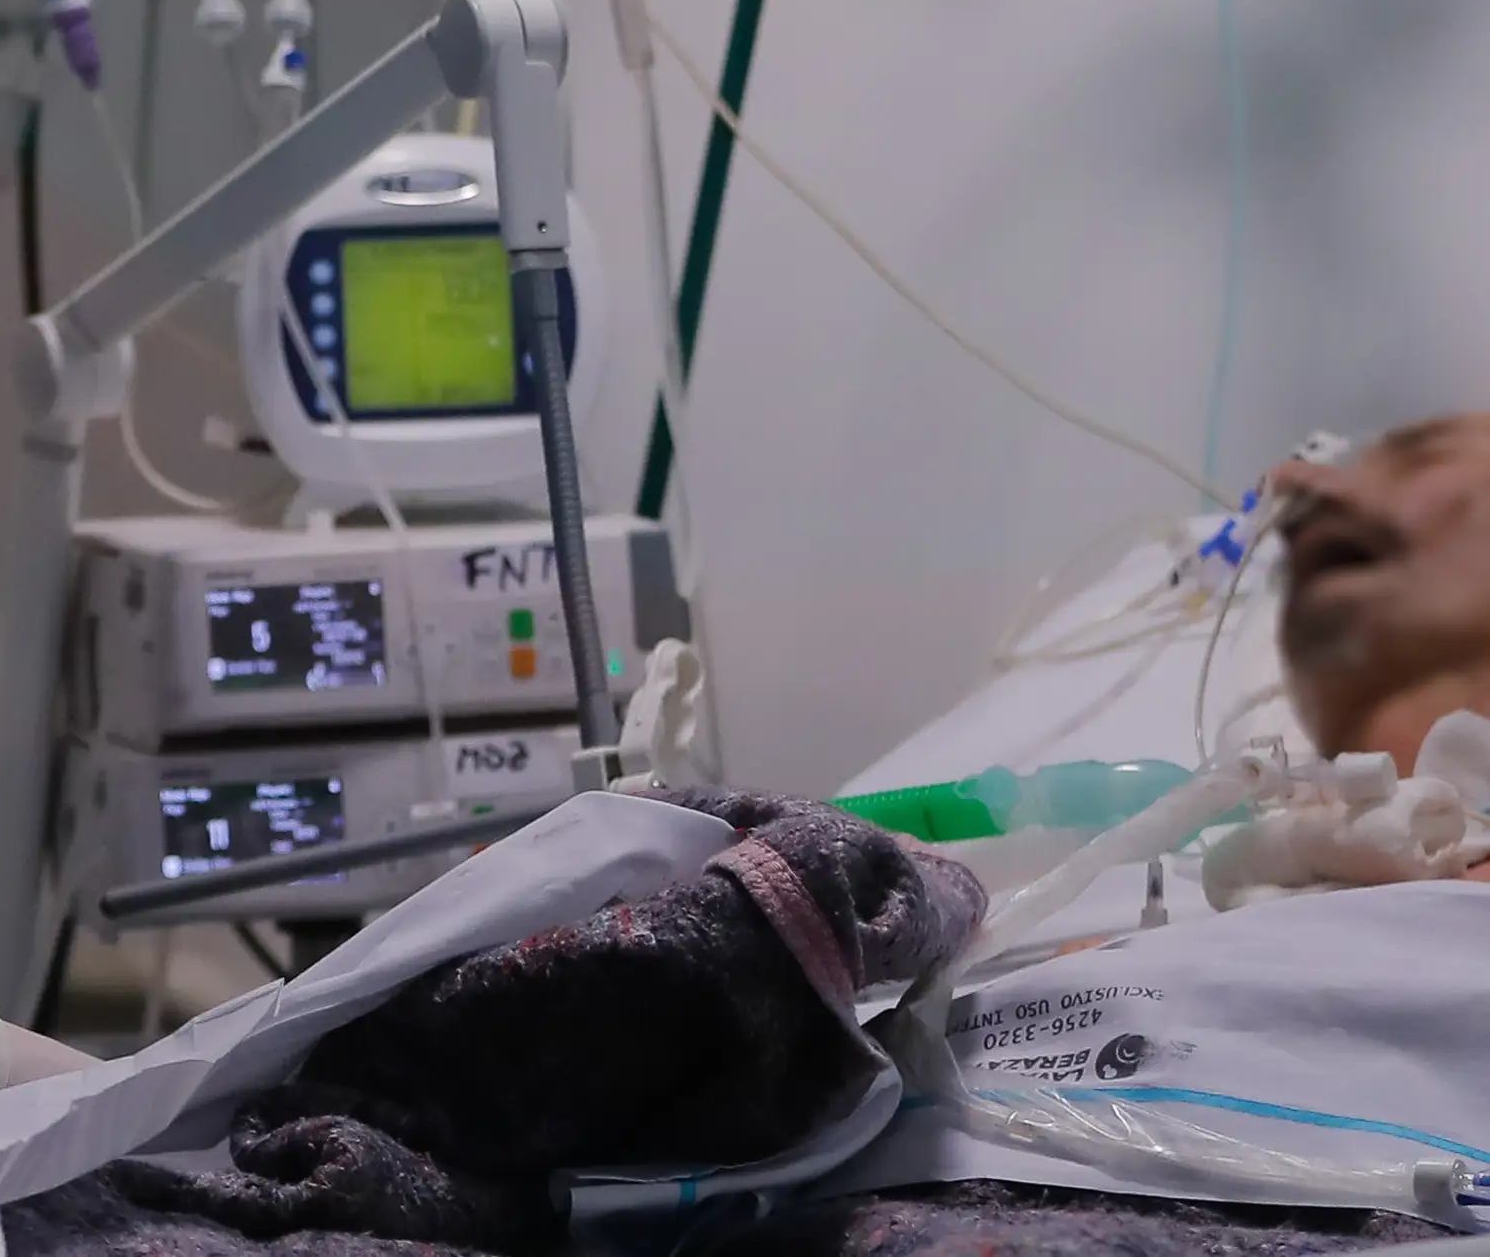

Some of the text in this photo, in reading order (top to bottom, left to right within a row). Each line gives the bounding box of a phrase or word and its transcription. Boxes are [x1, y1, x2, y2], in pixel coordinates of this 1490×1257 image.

[1015, 998, 1050, 1020] USO
[1060, 986, 1165, 1009] EXCLUSIVO
[983, 1008, 1103, 1051] 4256-3320
[975, 1049, 1092, 1072] BERAZA
